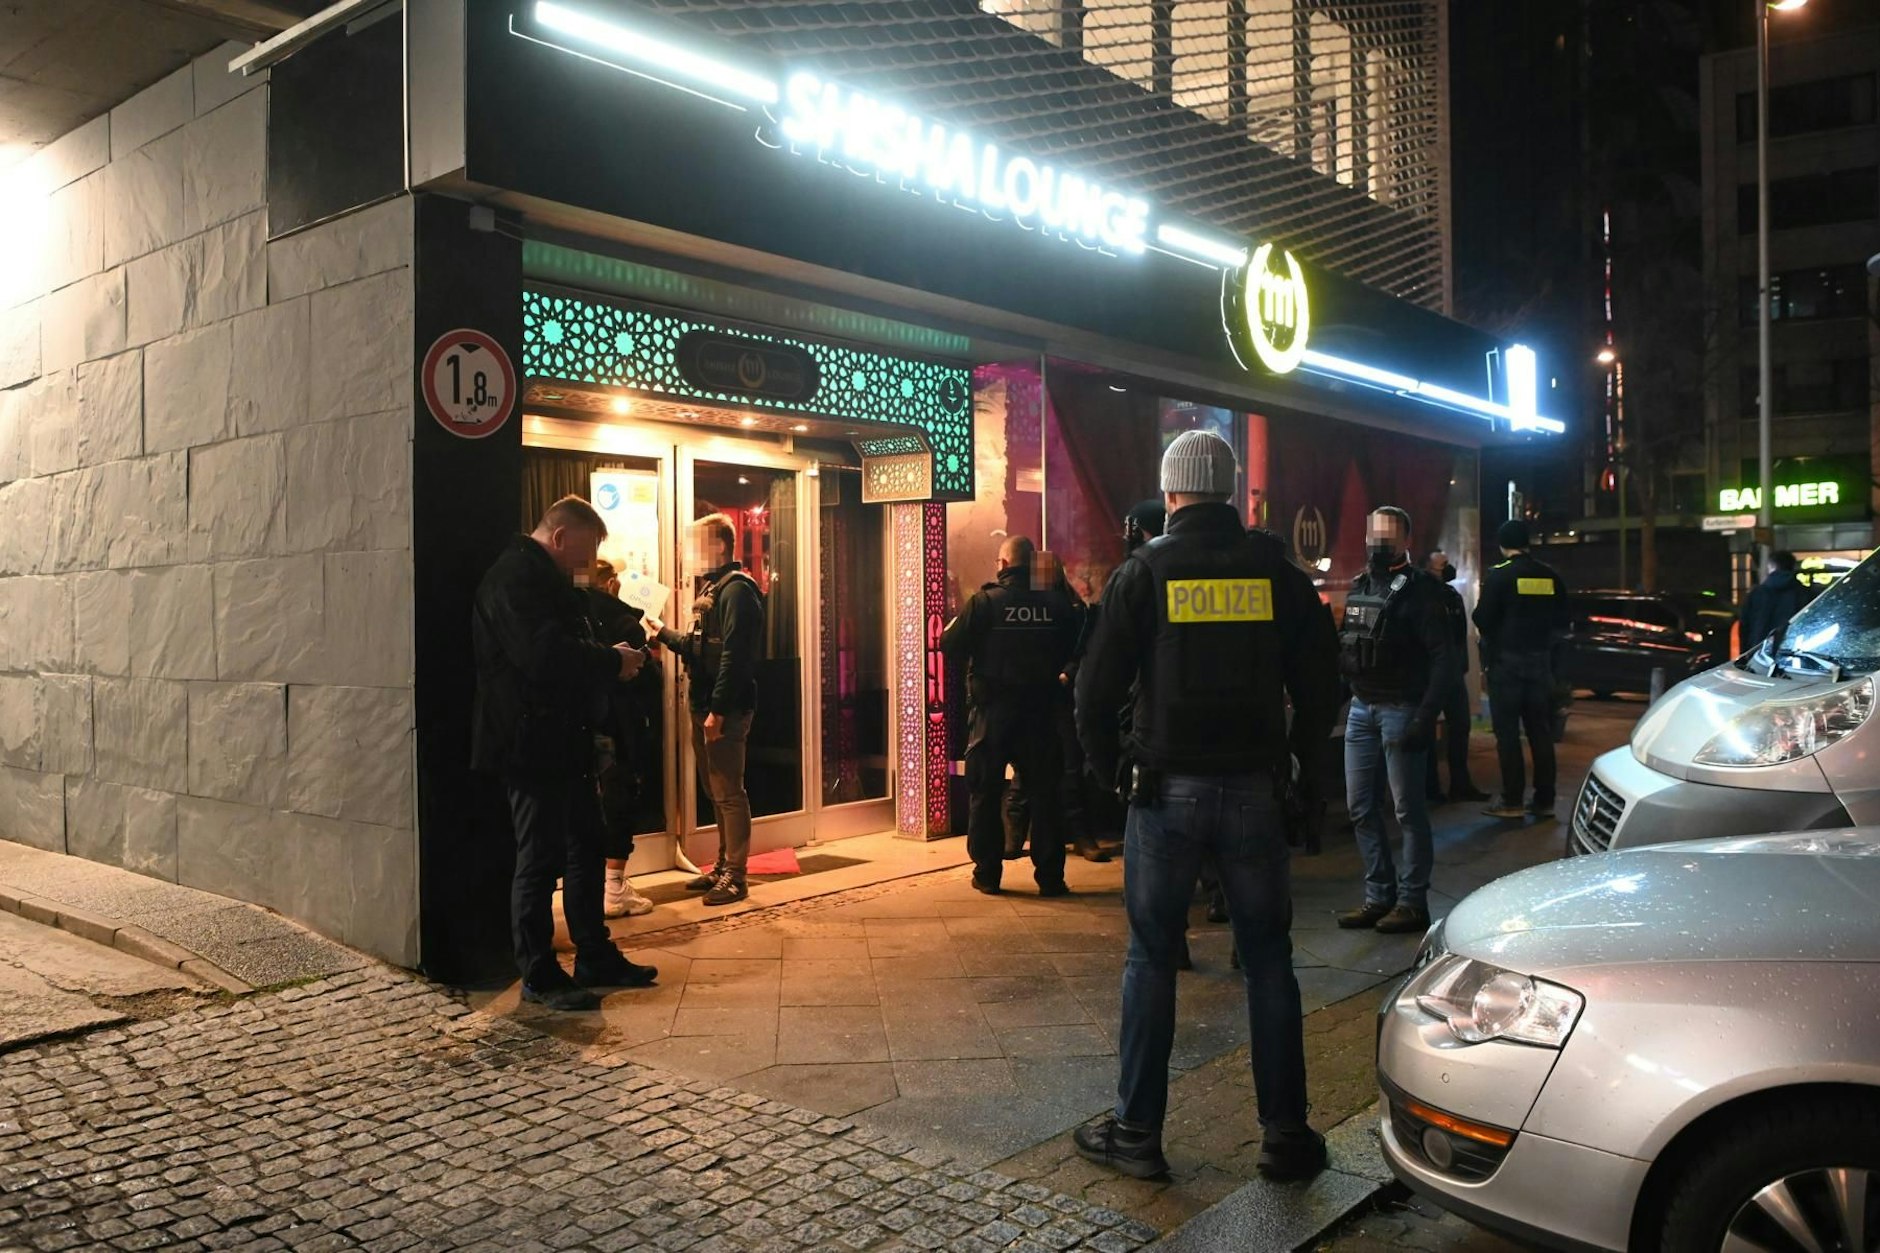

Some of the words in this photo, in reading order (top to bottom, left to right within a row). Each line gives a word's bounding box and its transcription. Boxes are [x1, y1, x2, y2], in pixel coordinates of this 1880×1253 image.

[979, 143, 1149, 254] LOUNGE
[1004, 606, 1054, 622] ZOLL
[1173, 585, 1269, 615] POLIZEI
